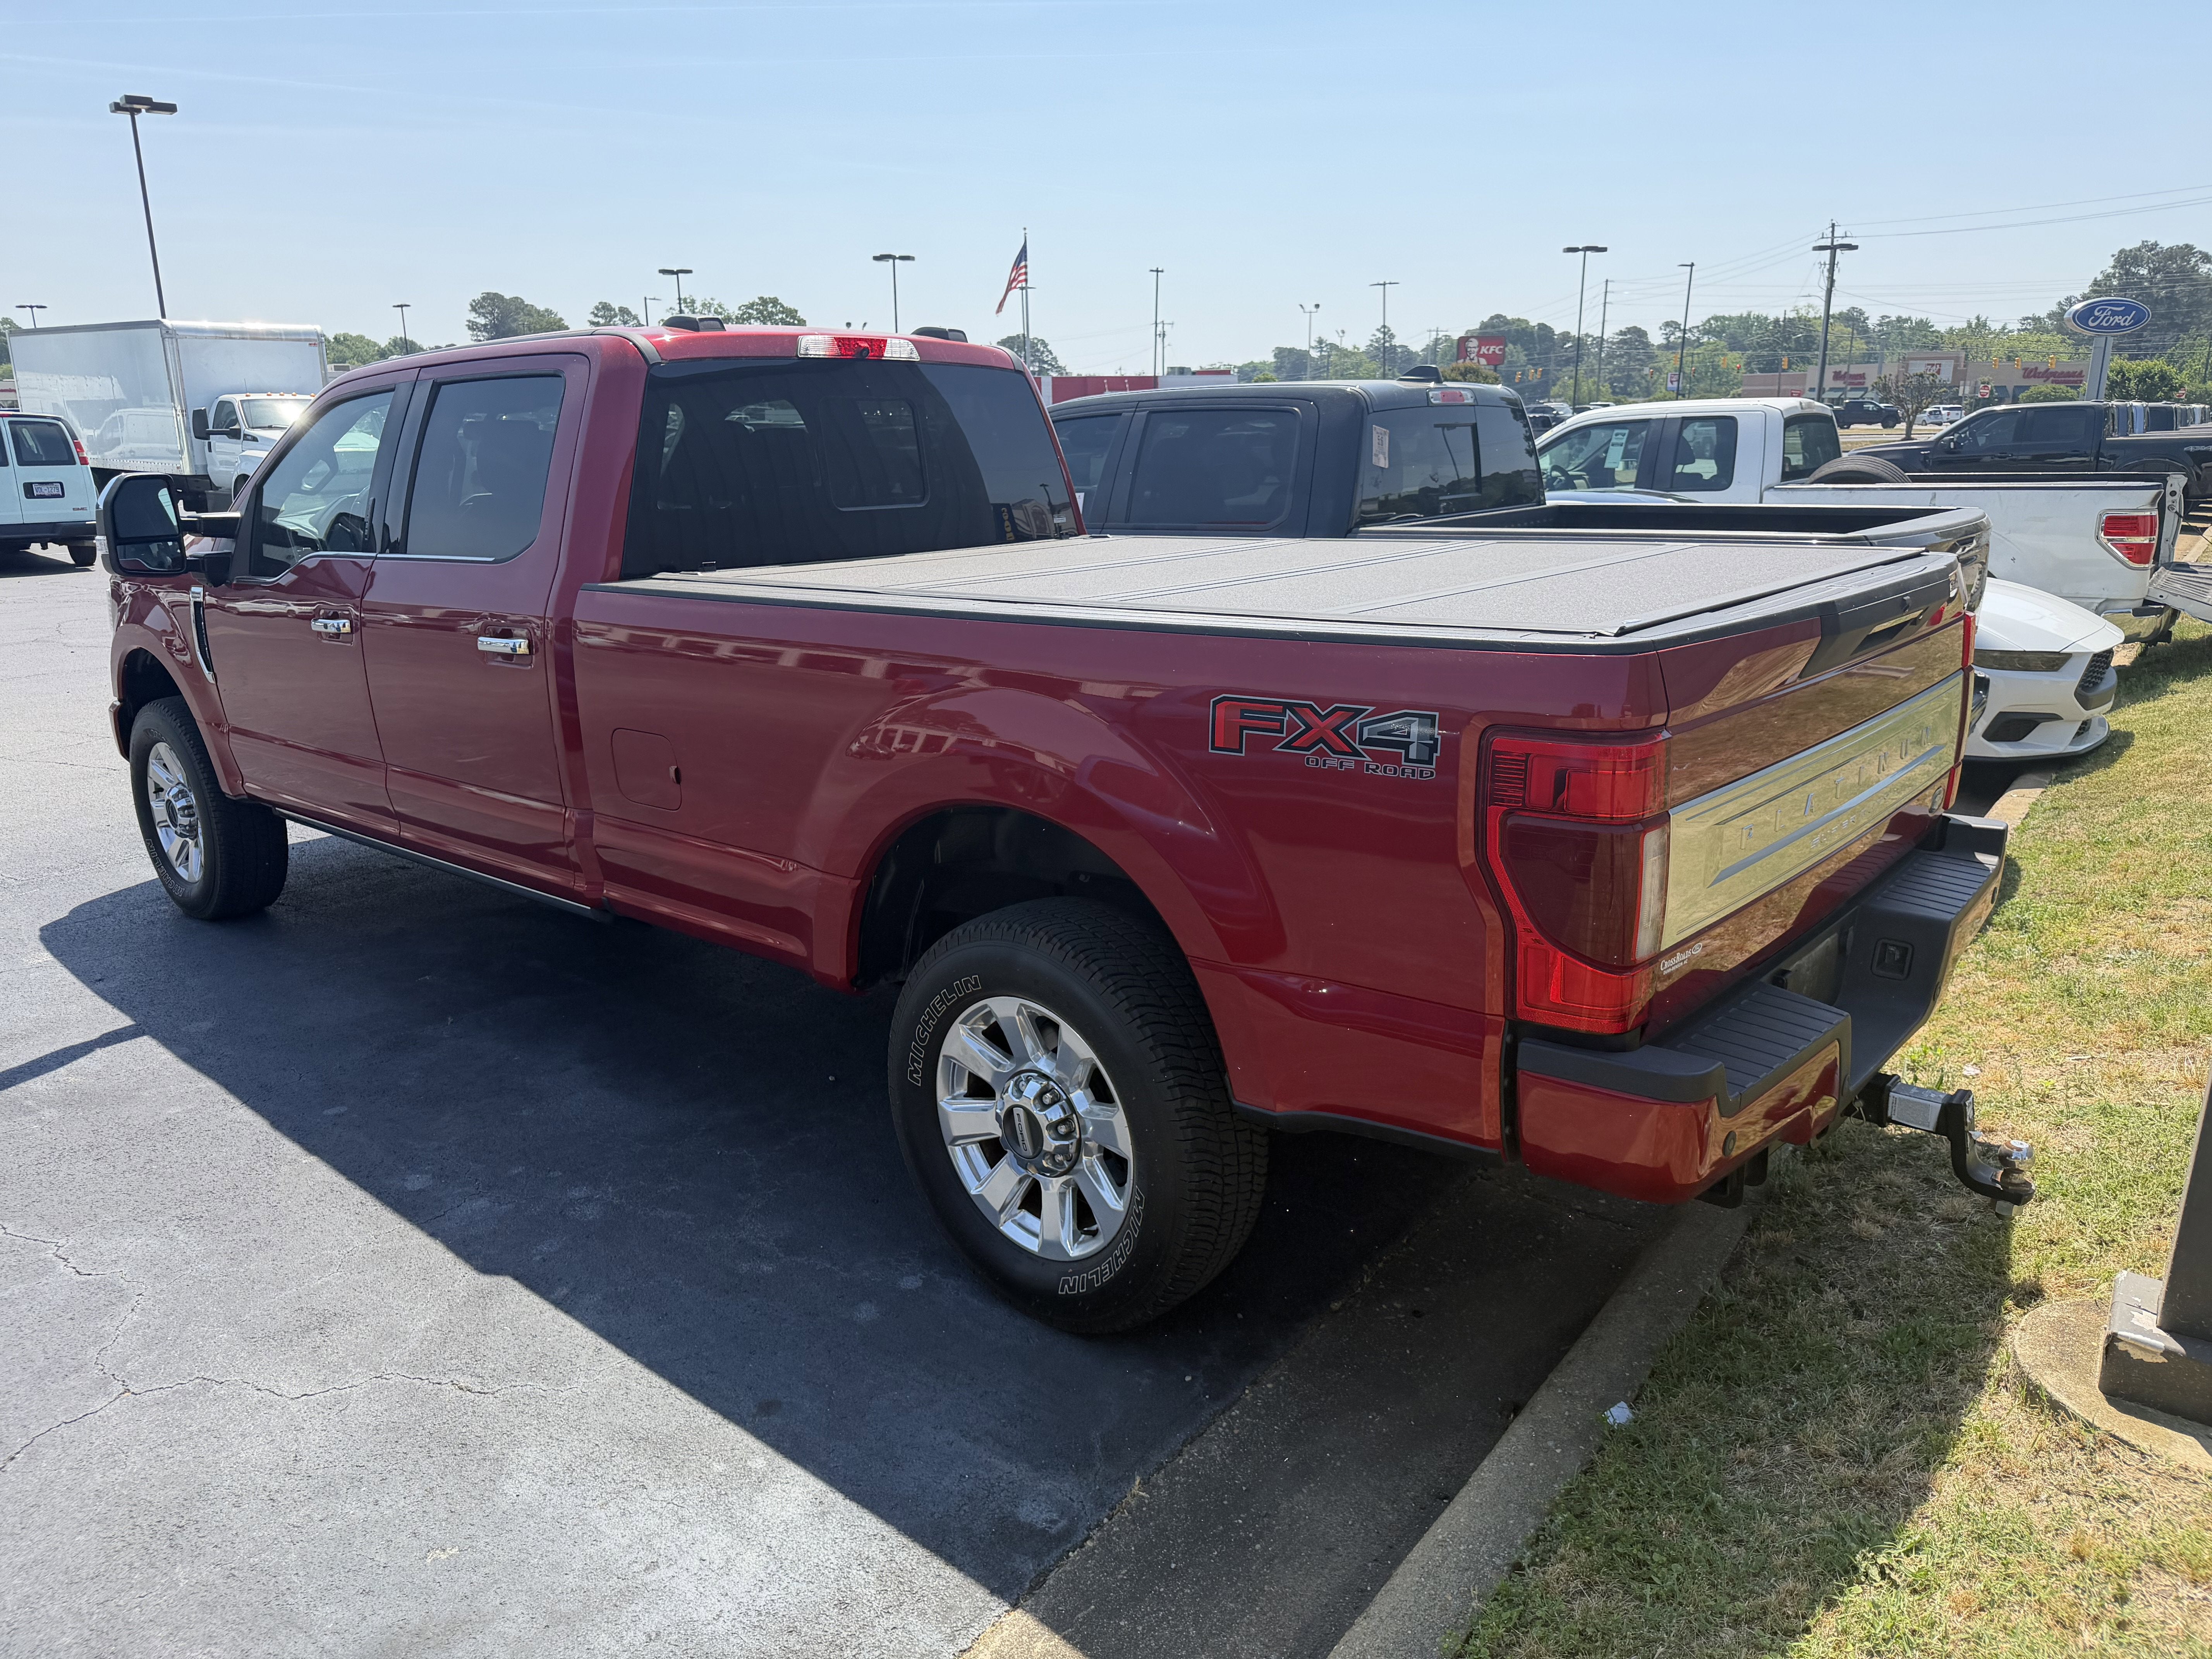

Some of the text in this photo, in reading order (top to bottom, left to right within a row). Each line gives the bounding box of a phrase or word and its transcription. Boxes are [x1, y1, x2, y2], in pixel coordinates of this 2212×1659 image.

[2088, 306, 2136, 326] Ford
[1479, 346, 1504, 354] KFC
[1209, 694, 1441, 768] FX4
[1304, 755, 1436, 780] OFF ROAD
[1740, 726, 1931, 850] PLATINUM
[145, 839, 185, 897] MICHELIN
[908, 975, 982, 1087] MICHELIN
[1017, 1113, 1027, 1151] FORD
[1058, 1185, 1145, 1295] MICHELIN
